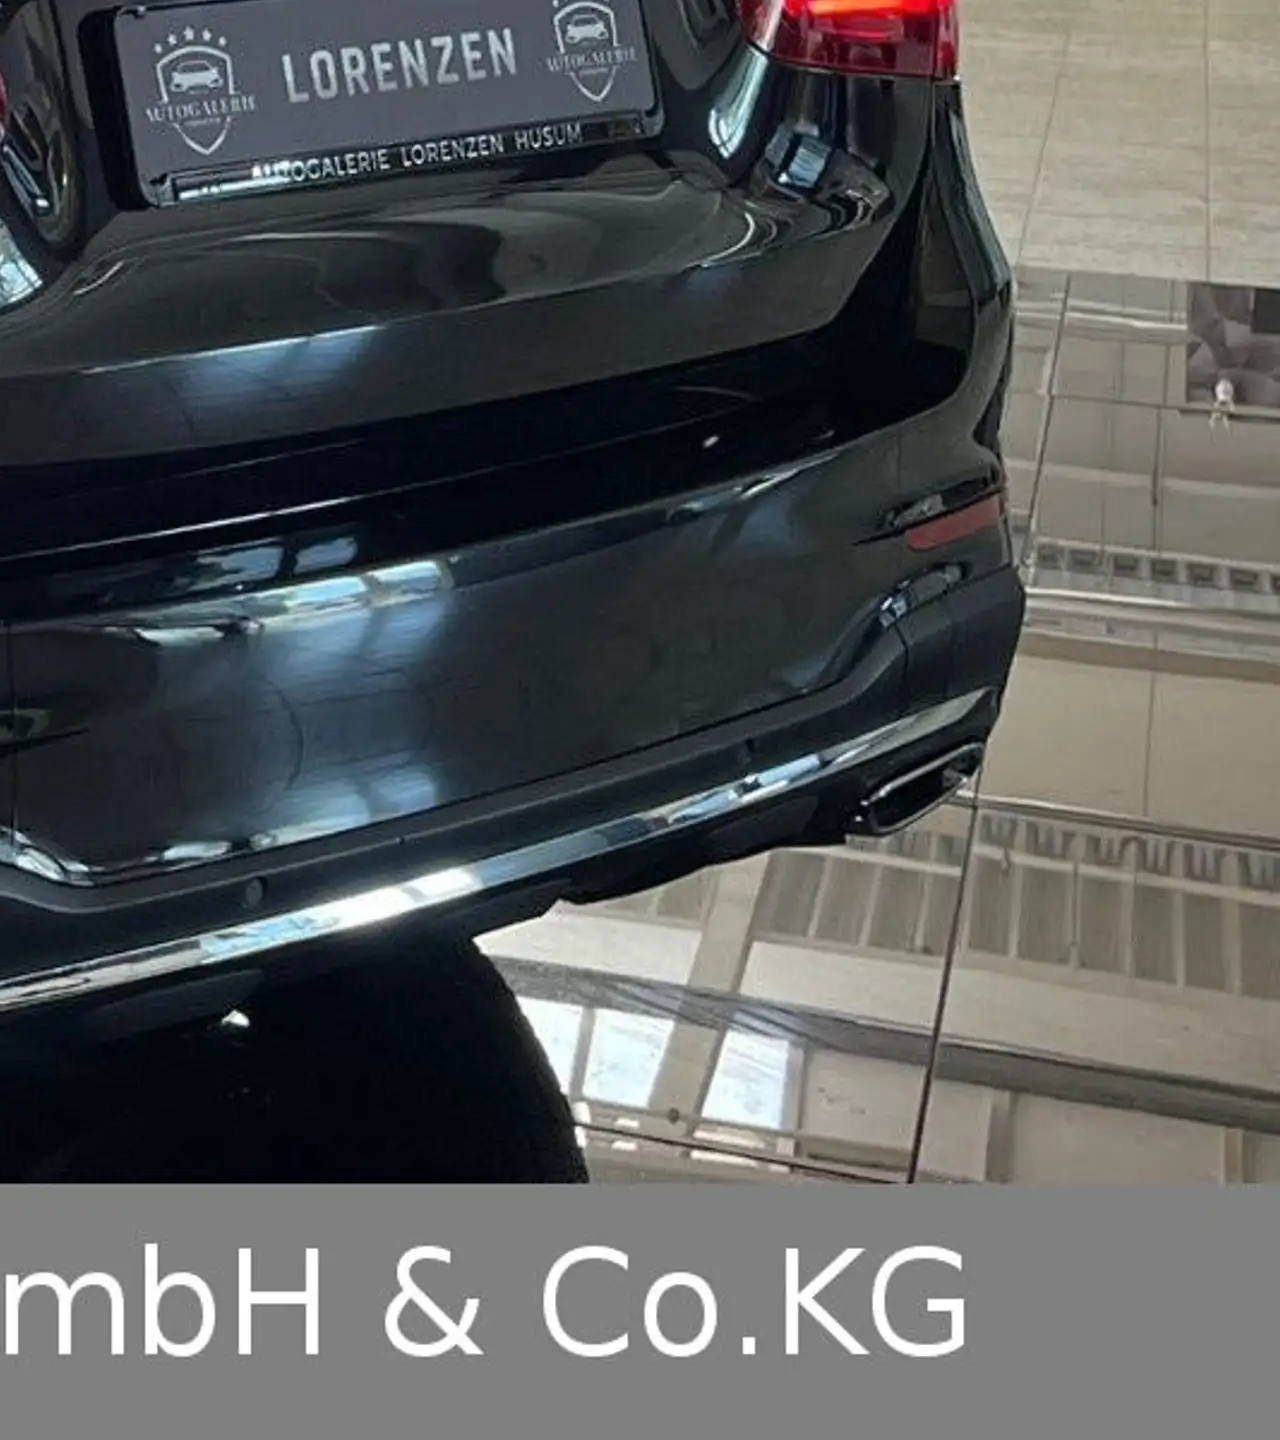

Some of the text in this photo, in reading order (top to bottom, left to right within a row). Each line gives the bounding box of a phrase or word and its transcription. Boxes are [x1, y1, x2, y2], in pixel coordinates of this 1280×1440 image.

[281, 27, 517, 103] LORENZEN
[251, 121, 584, 182] AUTOGALERIE LORENZEN HUSUM
